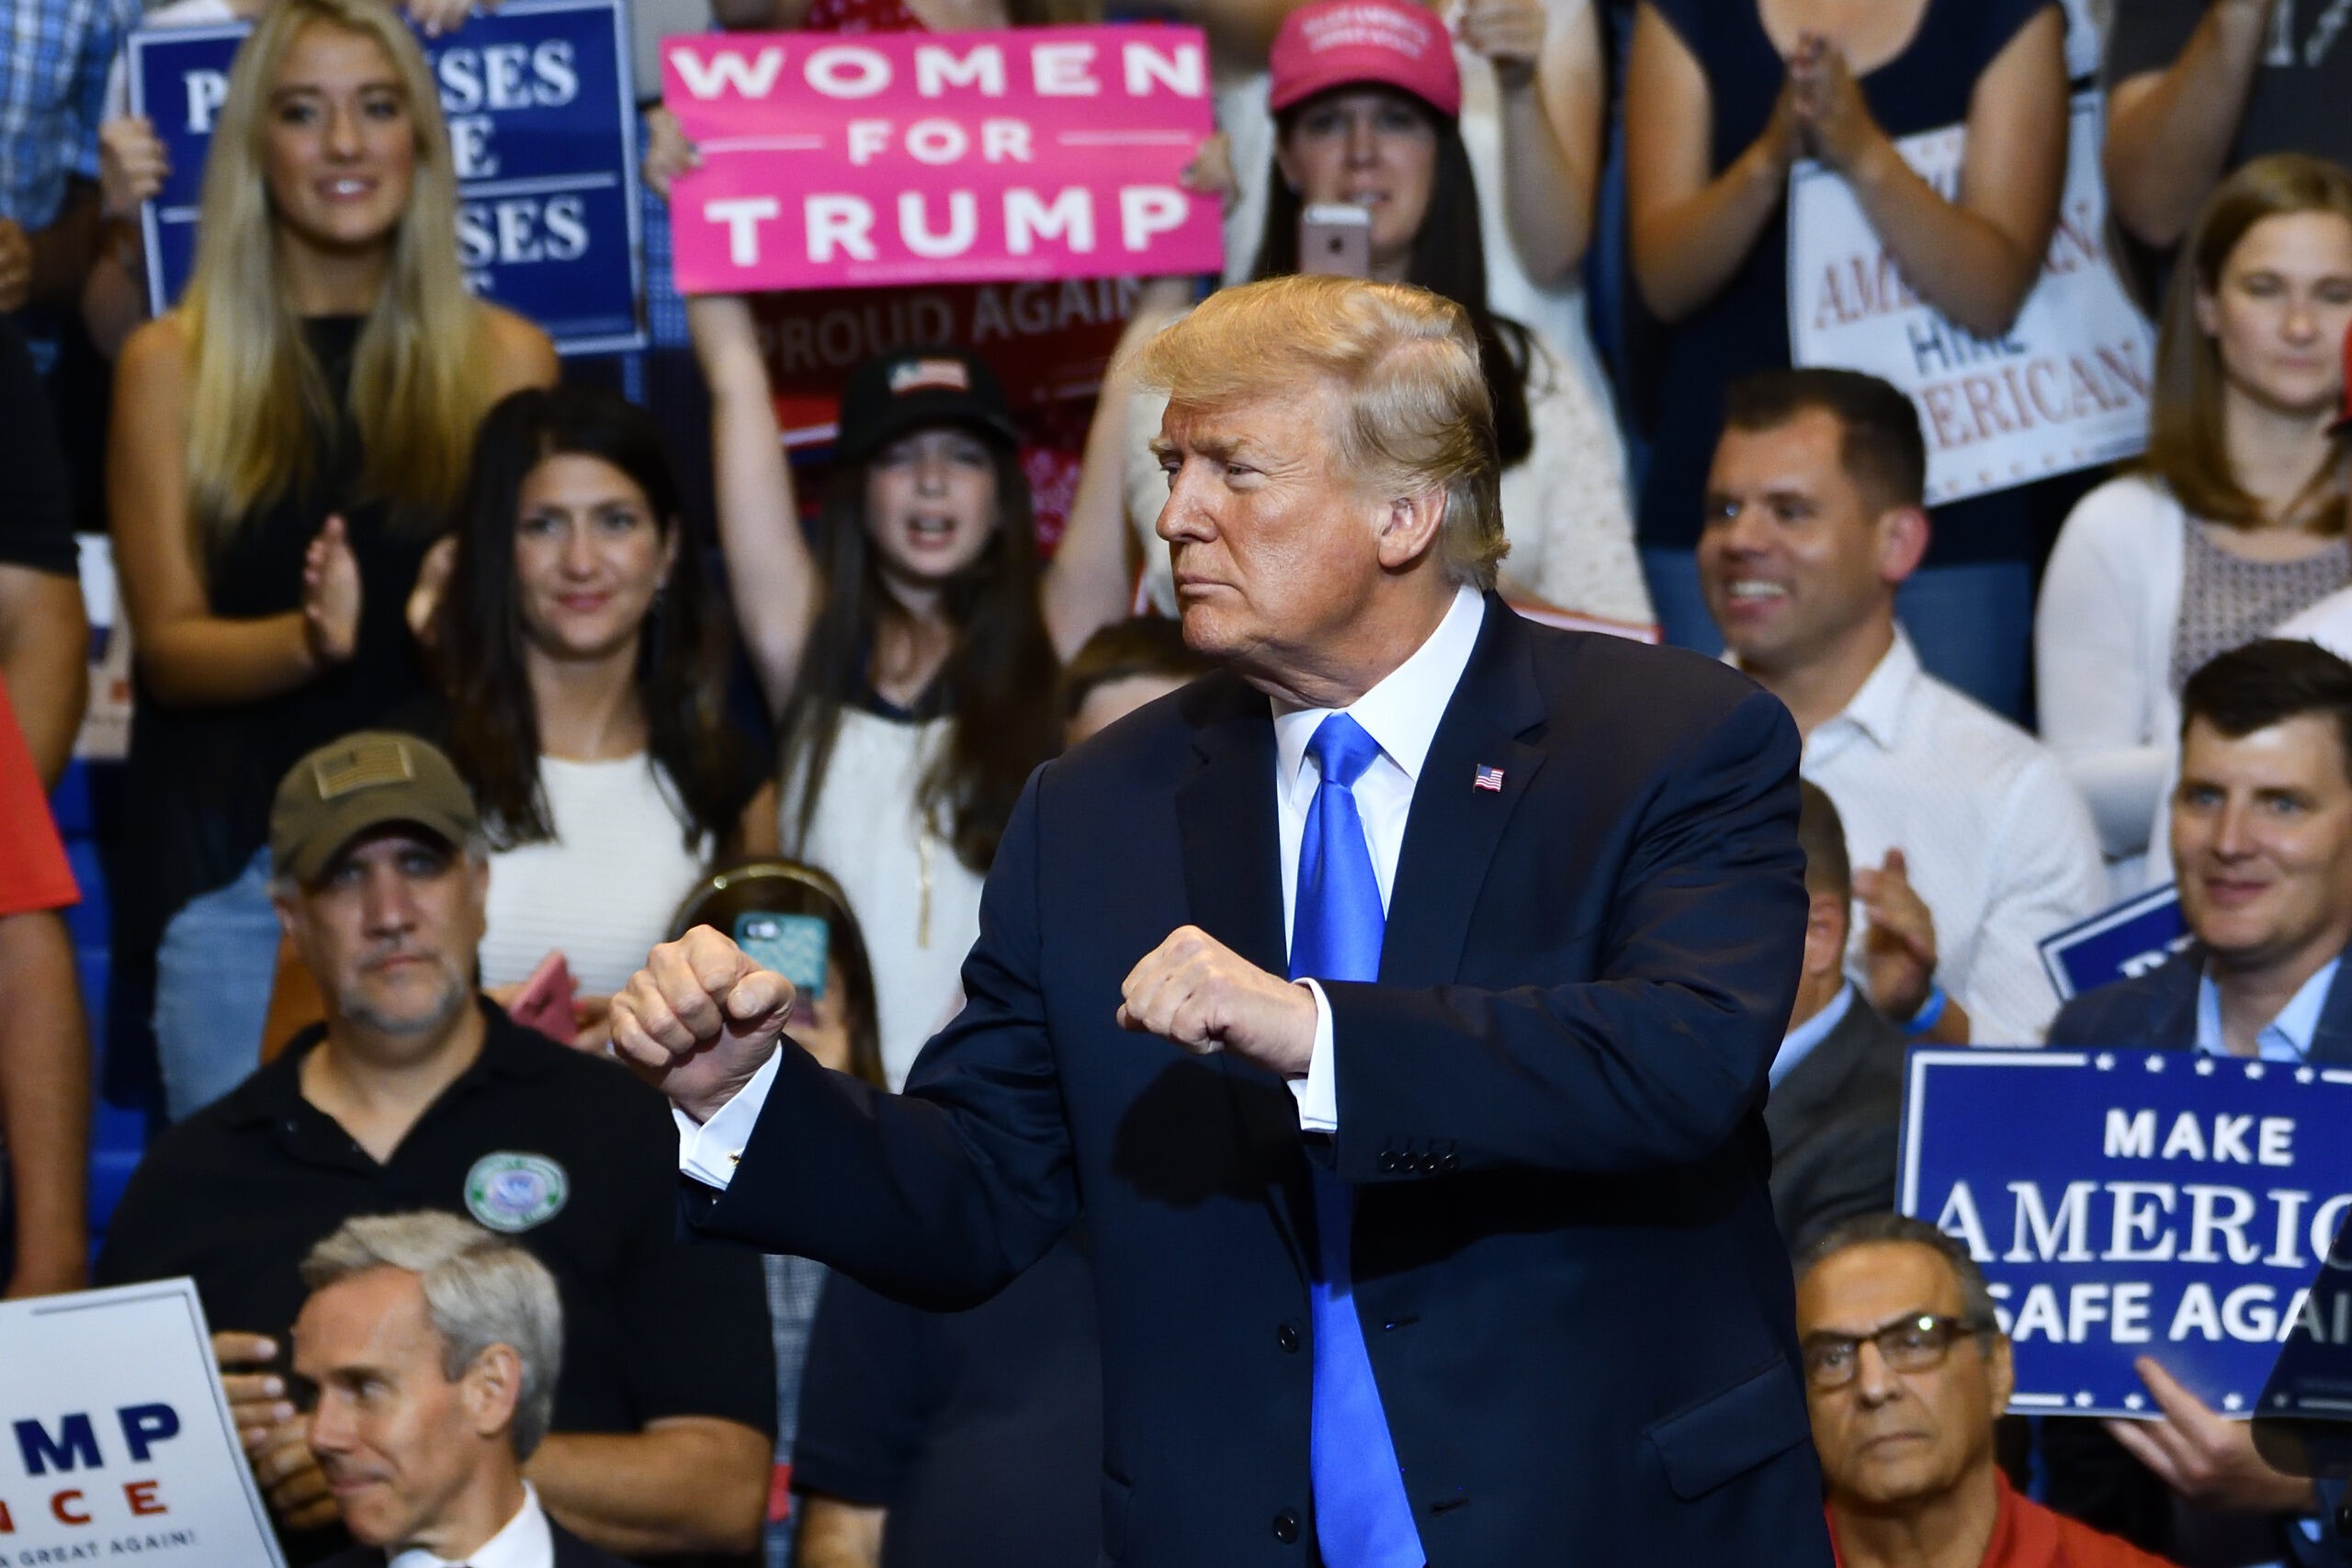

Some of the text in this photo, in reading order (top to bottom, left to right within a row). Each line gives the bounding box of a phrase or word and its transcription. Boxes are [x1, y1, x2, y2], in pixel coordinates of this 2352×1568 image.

[670, 42, 1204, 100] WOMEN
[845, 118, 1035, 165] FOR
[704, 186, 1190, 266] TRUMP
[1920, 336, 2149, 448] ERICAN
[2102, 1108, 2297, 1167] MAKE
[1986, 1281, 2153, 1344] SAFE
[18, 1540, 99, 1566] GREAT
[109, 1529, 197, 1555] AGAIN!
